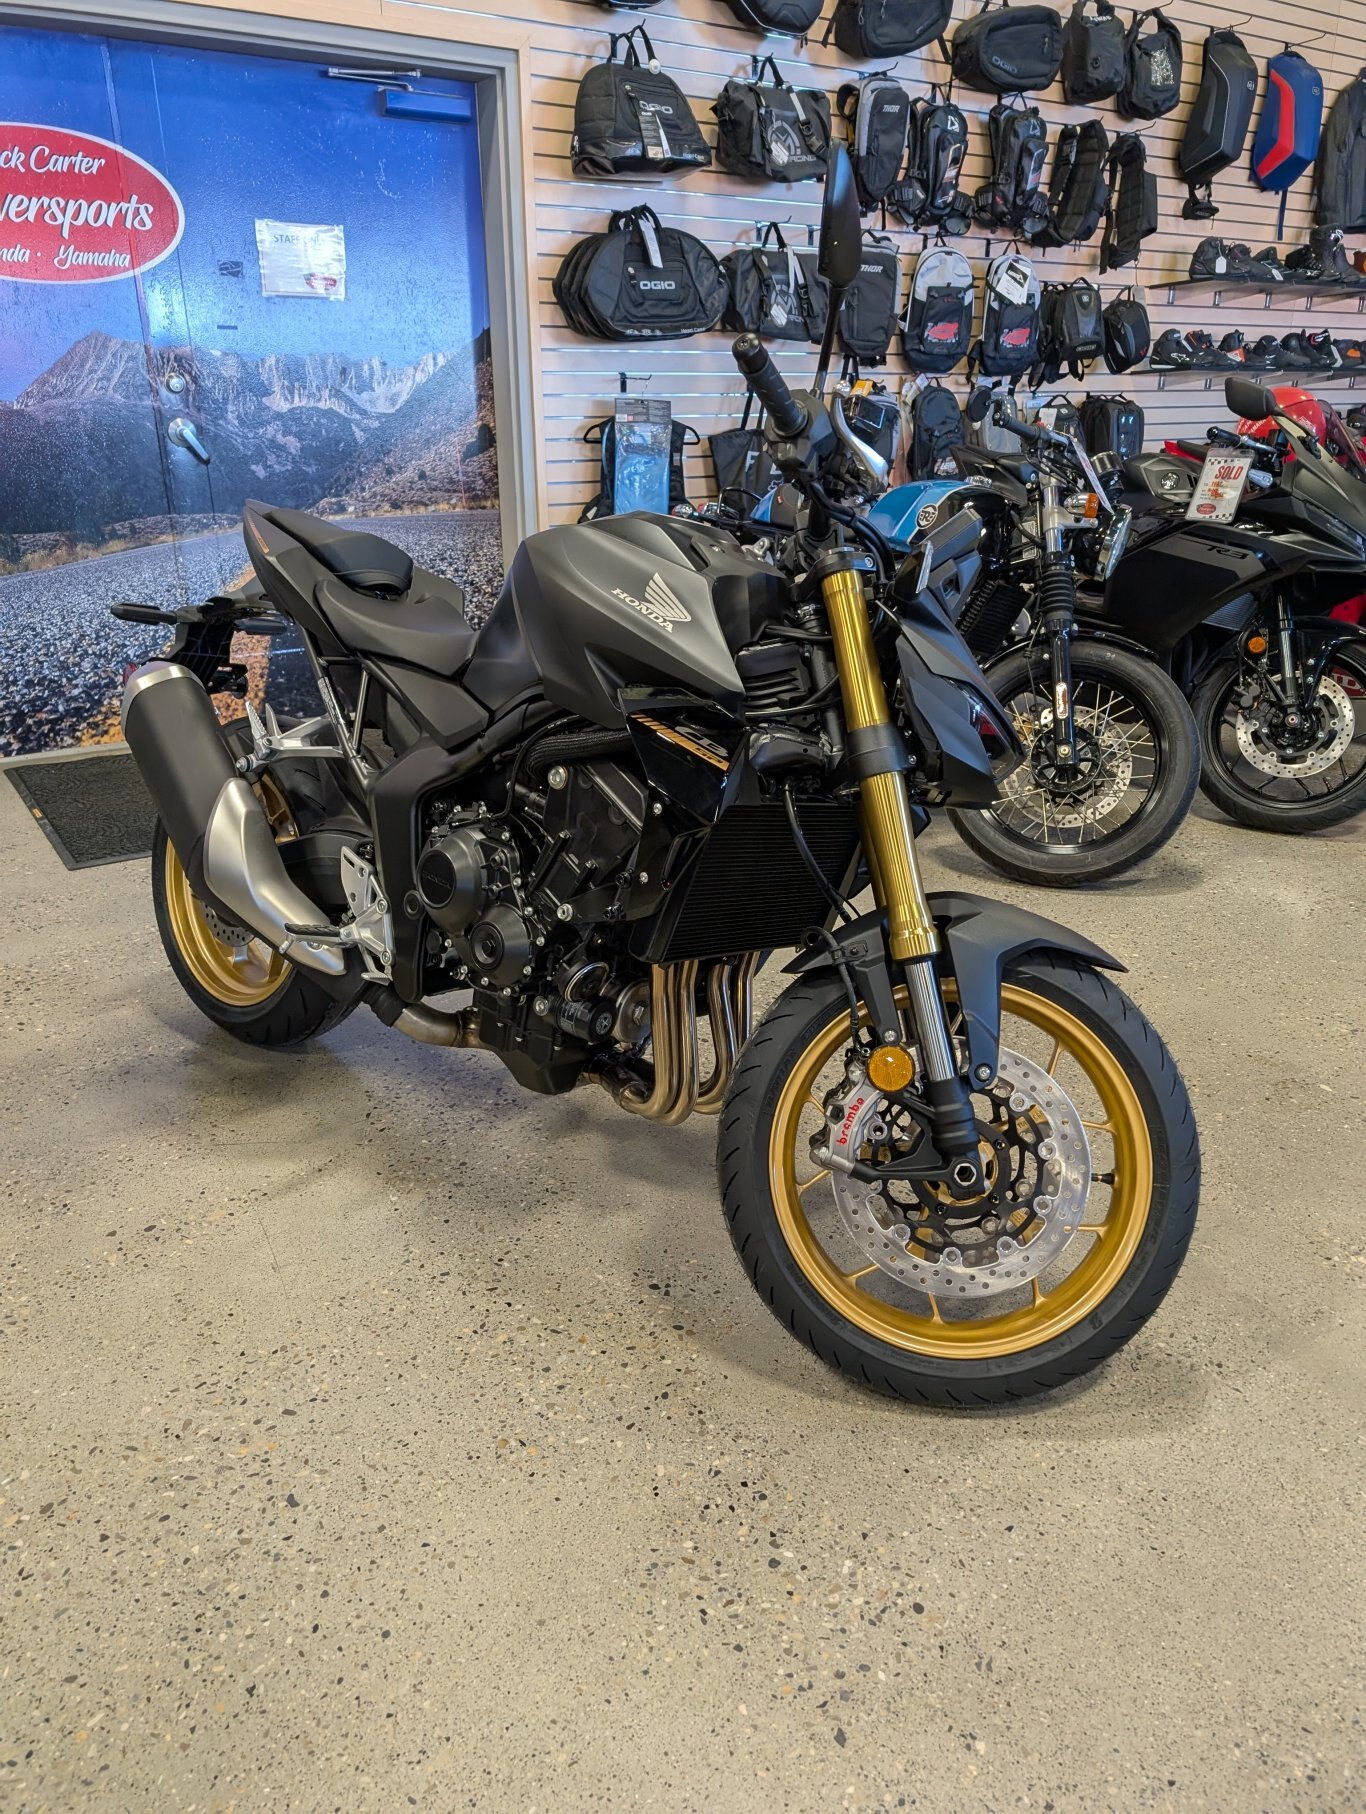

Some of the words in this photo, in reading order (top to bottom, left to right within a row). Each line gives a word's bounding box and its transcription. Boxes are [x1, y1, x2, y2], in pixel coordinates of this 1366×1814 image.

[992, 56, 1018, 74] OGIO
[882, 104, 900, 113] THOR
[30, 145, 105, 175] Carter
[53, 244, 130, 269] Yamaha
[860, 264, 883, 273] THOR
[640, 280, 675, 290] OGIO
[1215, 465, 1243, 480] SOLD
[611, 587, 674, 633] HONDA
[836, 1097, 865, 1145] brembo
